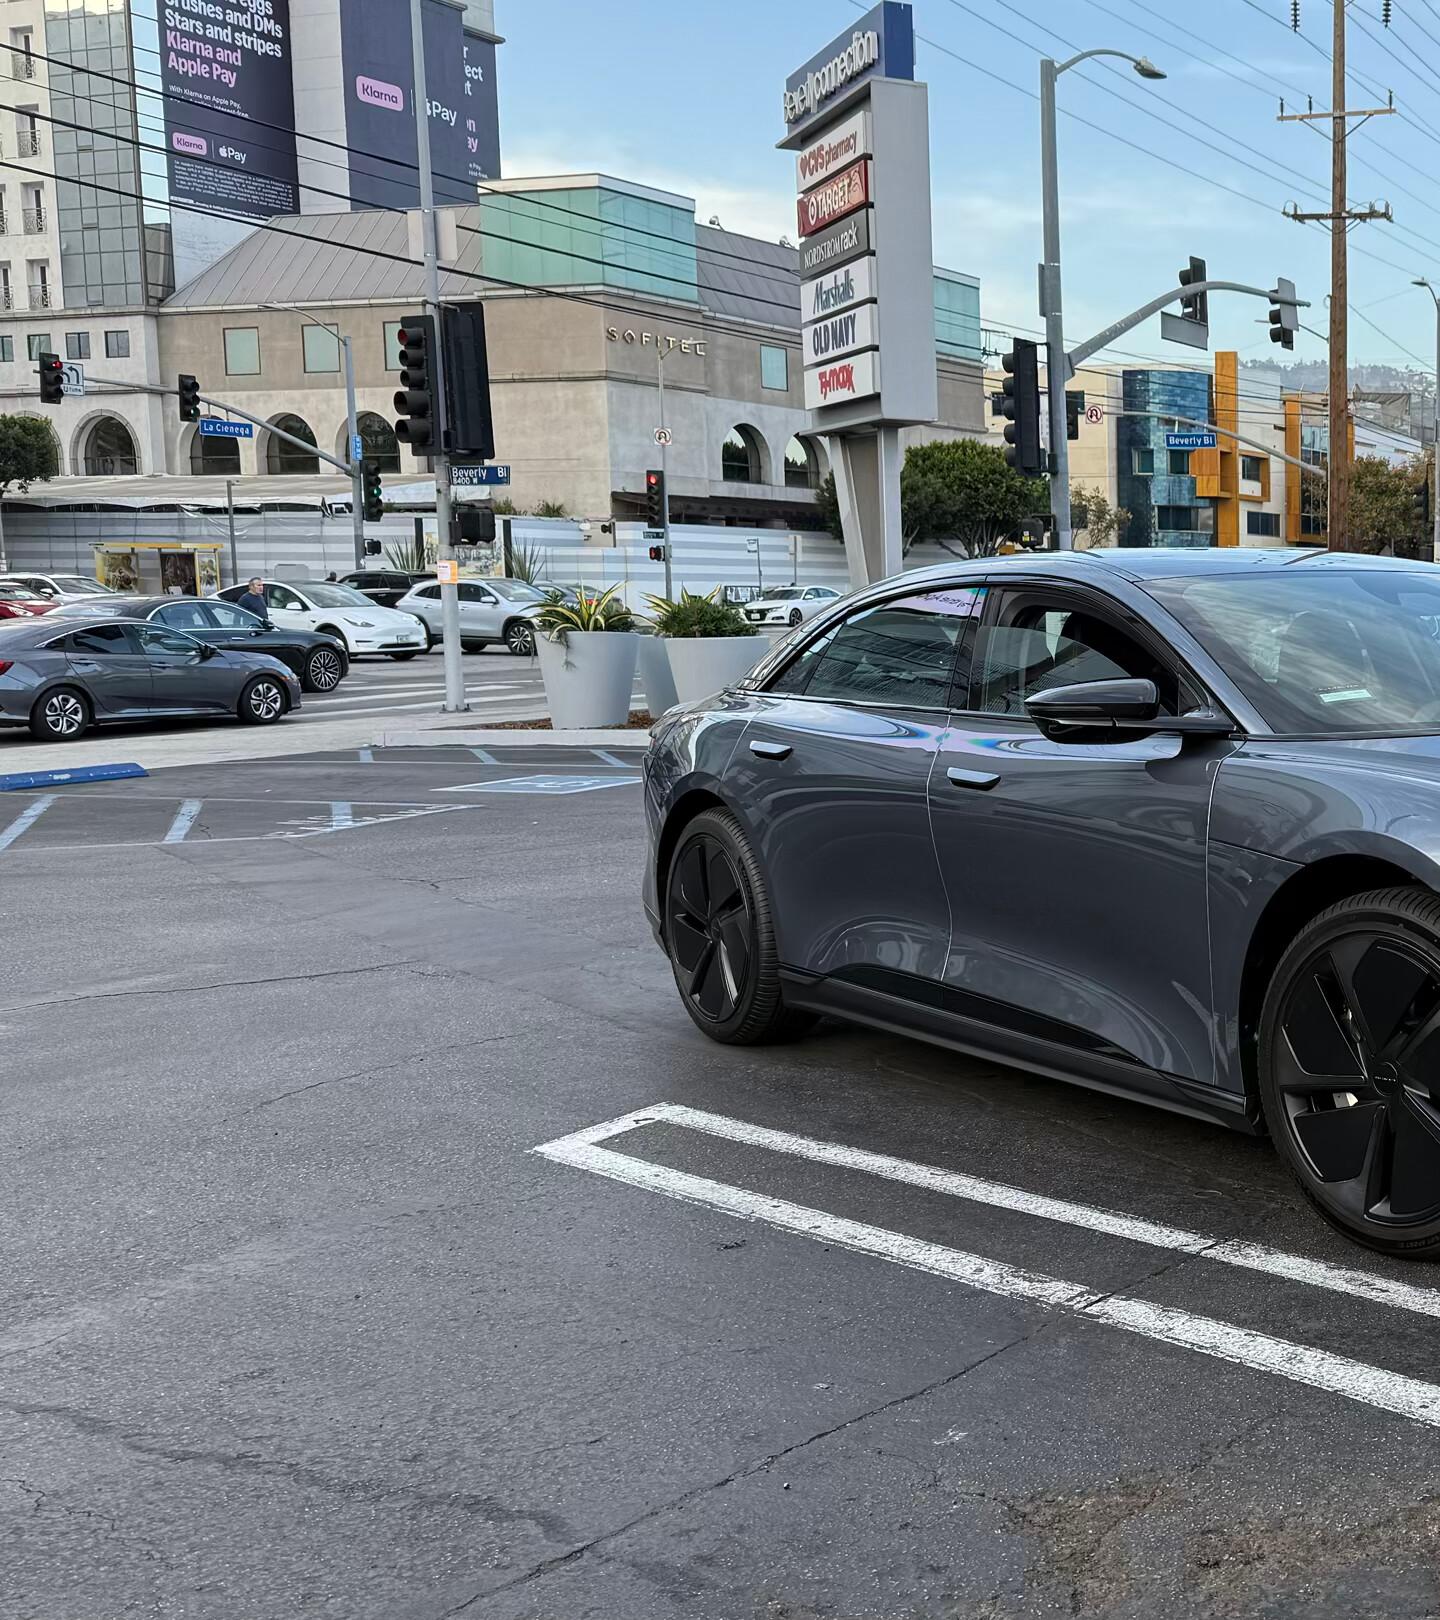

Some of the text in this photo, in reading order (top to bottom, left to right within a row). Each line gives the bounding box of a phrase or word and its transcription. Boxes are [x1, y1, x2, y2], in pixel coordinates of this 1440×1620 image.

[165, 8, 282, 57] Stars and stripes
[225, 9, 252, 29] and
[254, 14, 283, 38] DMs
[166, 29, 242, 66] Klarna and
[168, 51, 237, 88] Apple Pay
[813, 31, 879, 101] connection
[361, 83, 399, 104] Klarna
[431, 100, 458, 126] Pay
[176, 137, 204, 151] Klarna
[227, 147, 247, 164] Pay
[807, 130, 857, 177] CVS pharmacy
[816, 177, 851, 220] TARGET
[840, 220, 858, 250] rack
[813, 269, 855, 315] Marshalls
[606, 326, 706, 356] SOFITEL
[813, 312, 857, 357] OLD NAVY
[203, 422, 250, 436] La Cienega
[1169, 436, 1213, 446] Beverly Bl
[452, 467, 507, 480] Beverly Bl
